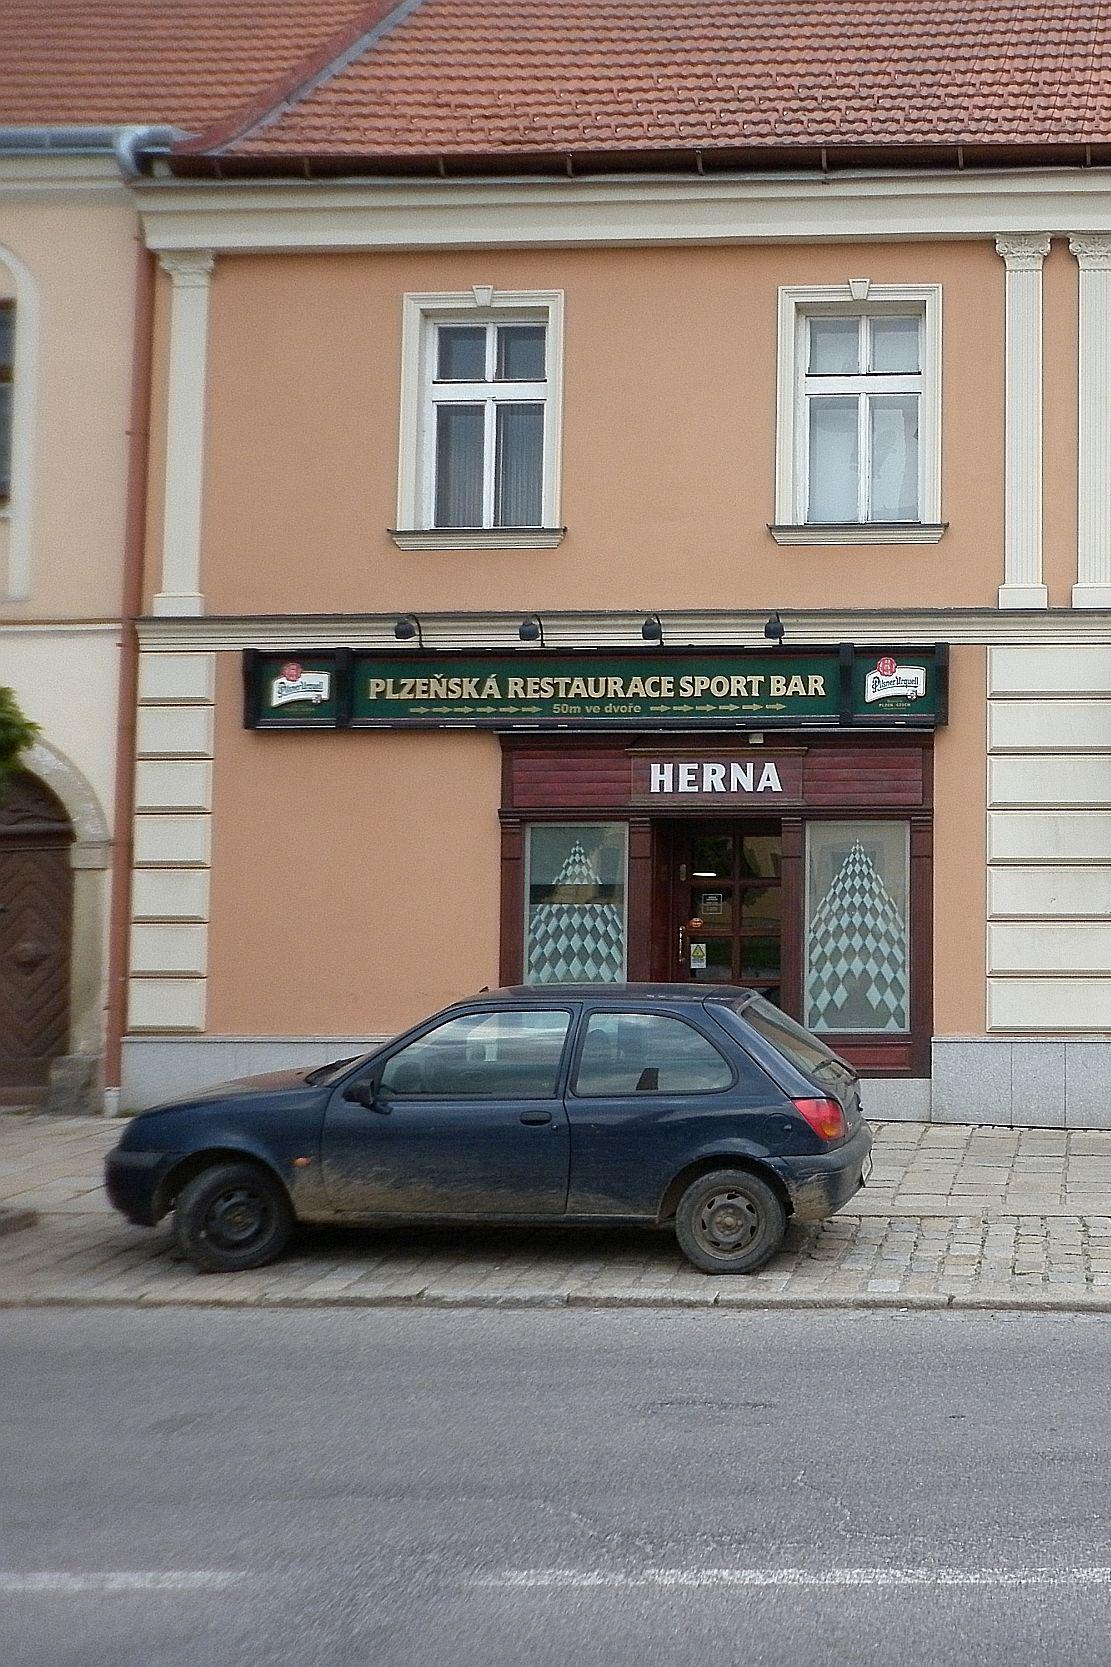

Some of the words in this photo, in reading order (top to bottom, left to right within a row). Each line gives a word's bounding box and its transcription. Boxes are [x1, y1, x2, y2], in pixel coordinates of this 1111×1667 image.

[369, 674, 501, 699] PLZEŇSKÁ
[508, 675, 673, 699] RESTAURACE
[679, 675, 764, 698] SPORT
[770, 674, 826, 697] BAR
[872, 676, 896, 693] Pilsner
[895, 676, 918, 688] Urquell
[604, 703, 641, 713] dvoře
[650, 762, 783, 793] HERNA
